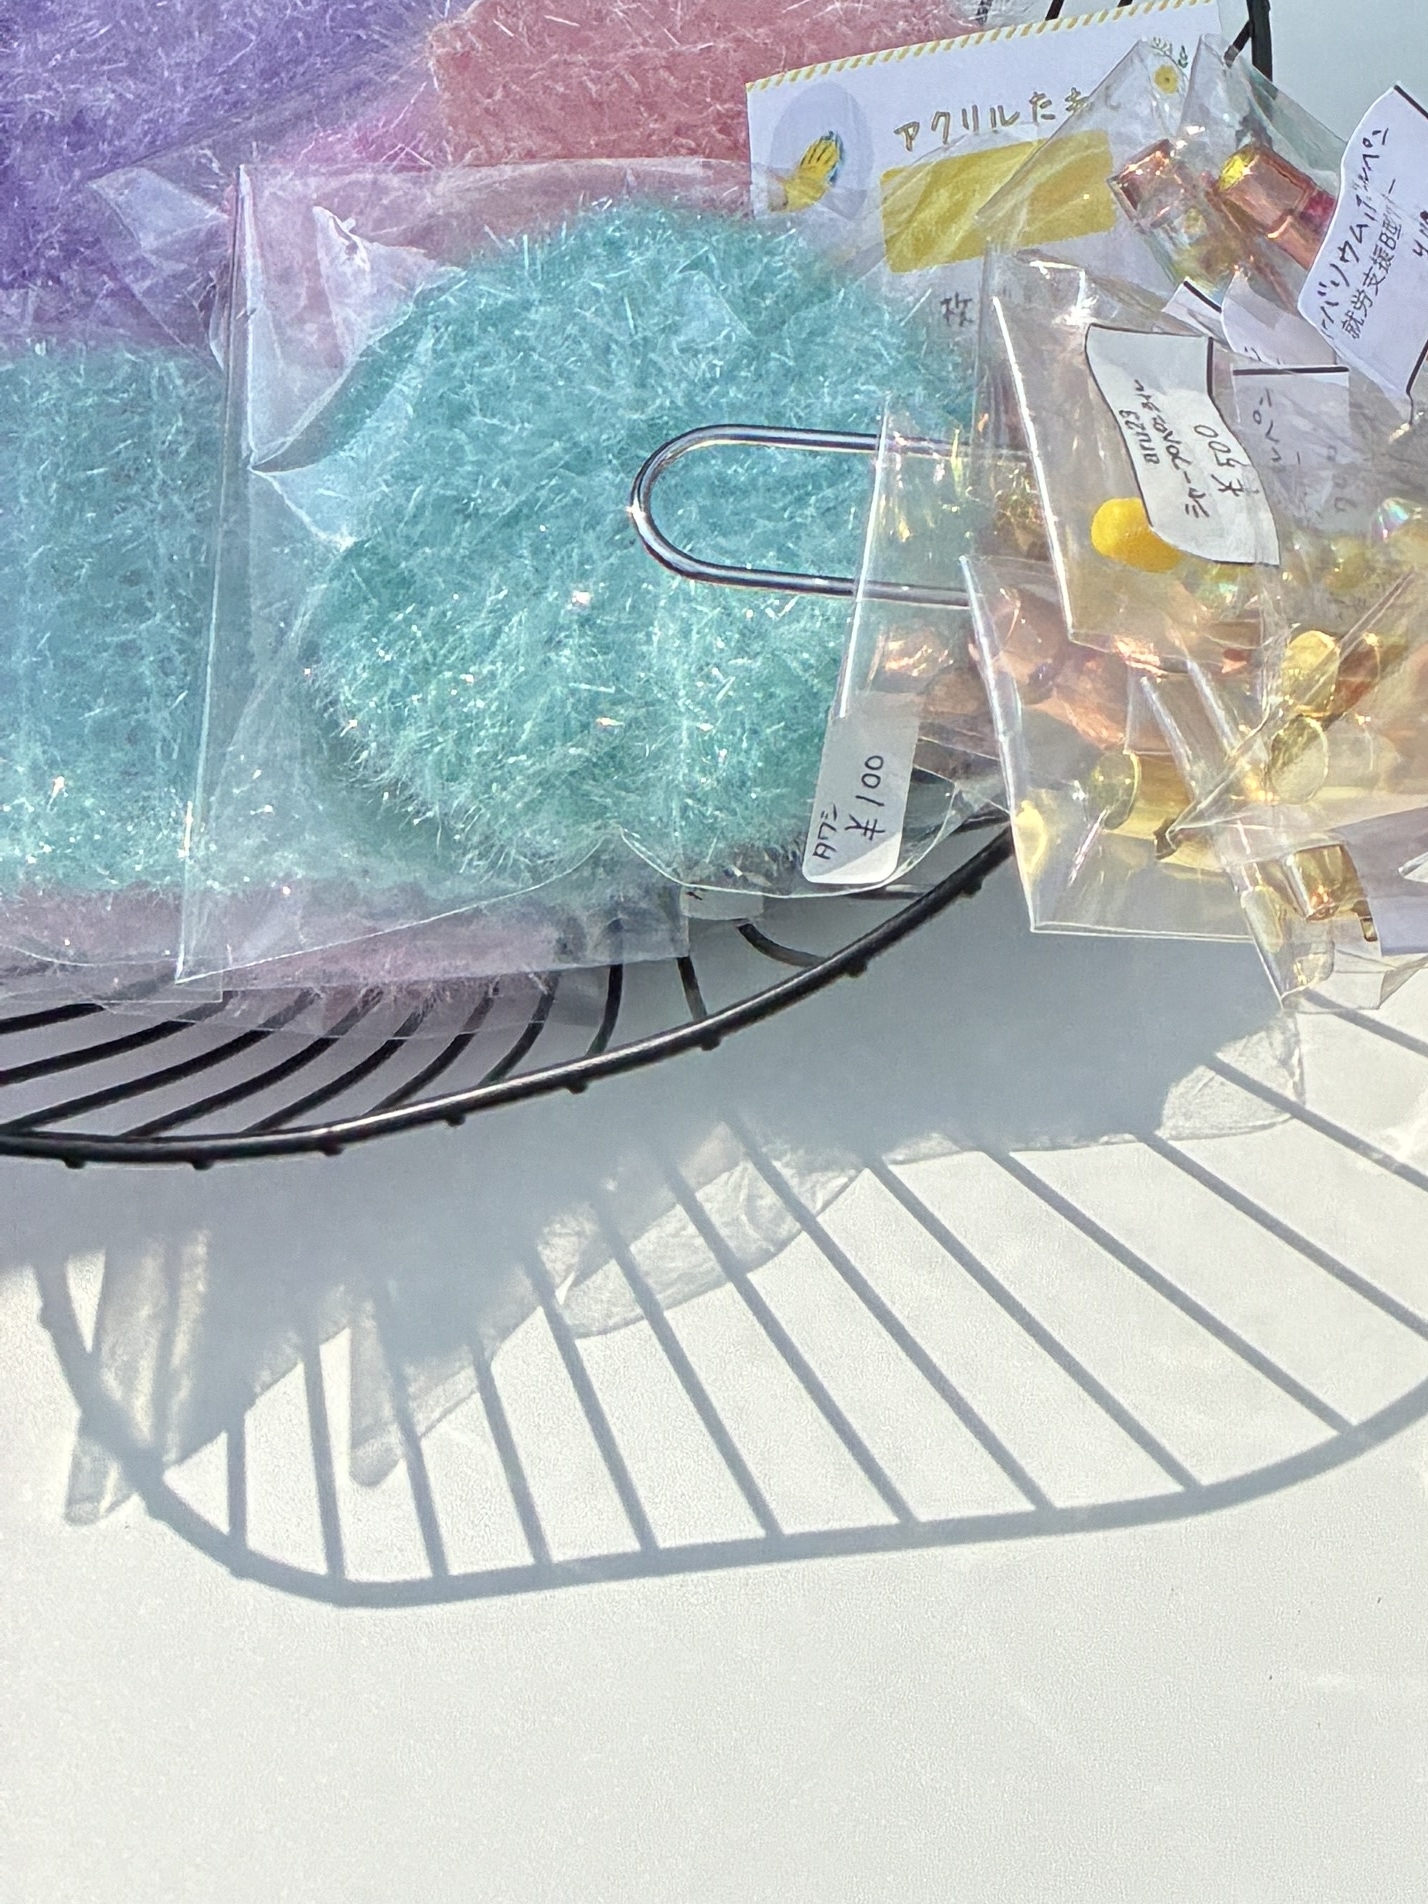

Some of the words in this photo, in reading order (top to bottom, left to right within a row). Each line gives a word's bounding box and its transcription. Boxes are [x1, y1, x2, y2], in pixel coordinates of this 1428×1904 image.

[1118, 408, 1161, 465] aru23
[1192, 423, 1252, 499] ¥500
[845, 752, 889, 845] ¥100
